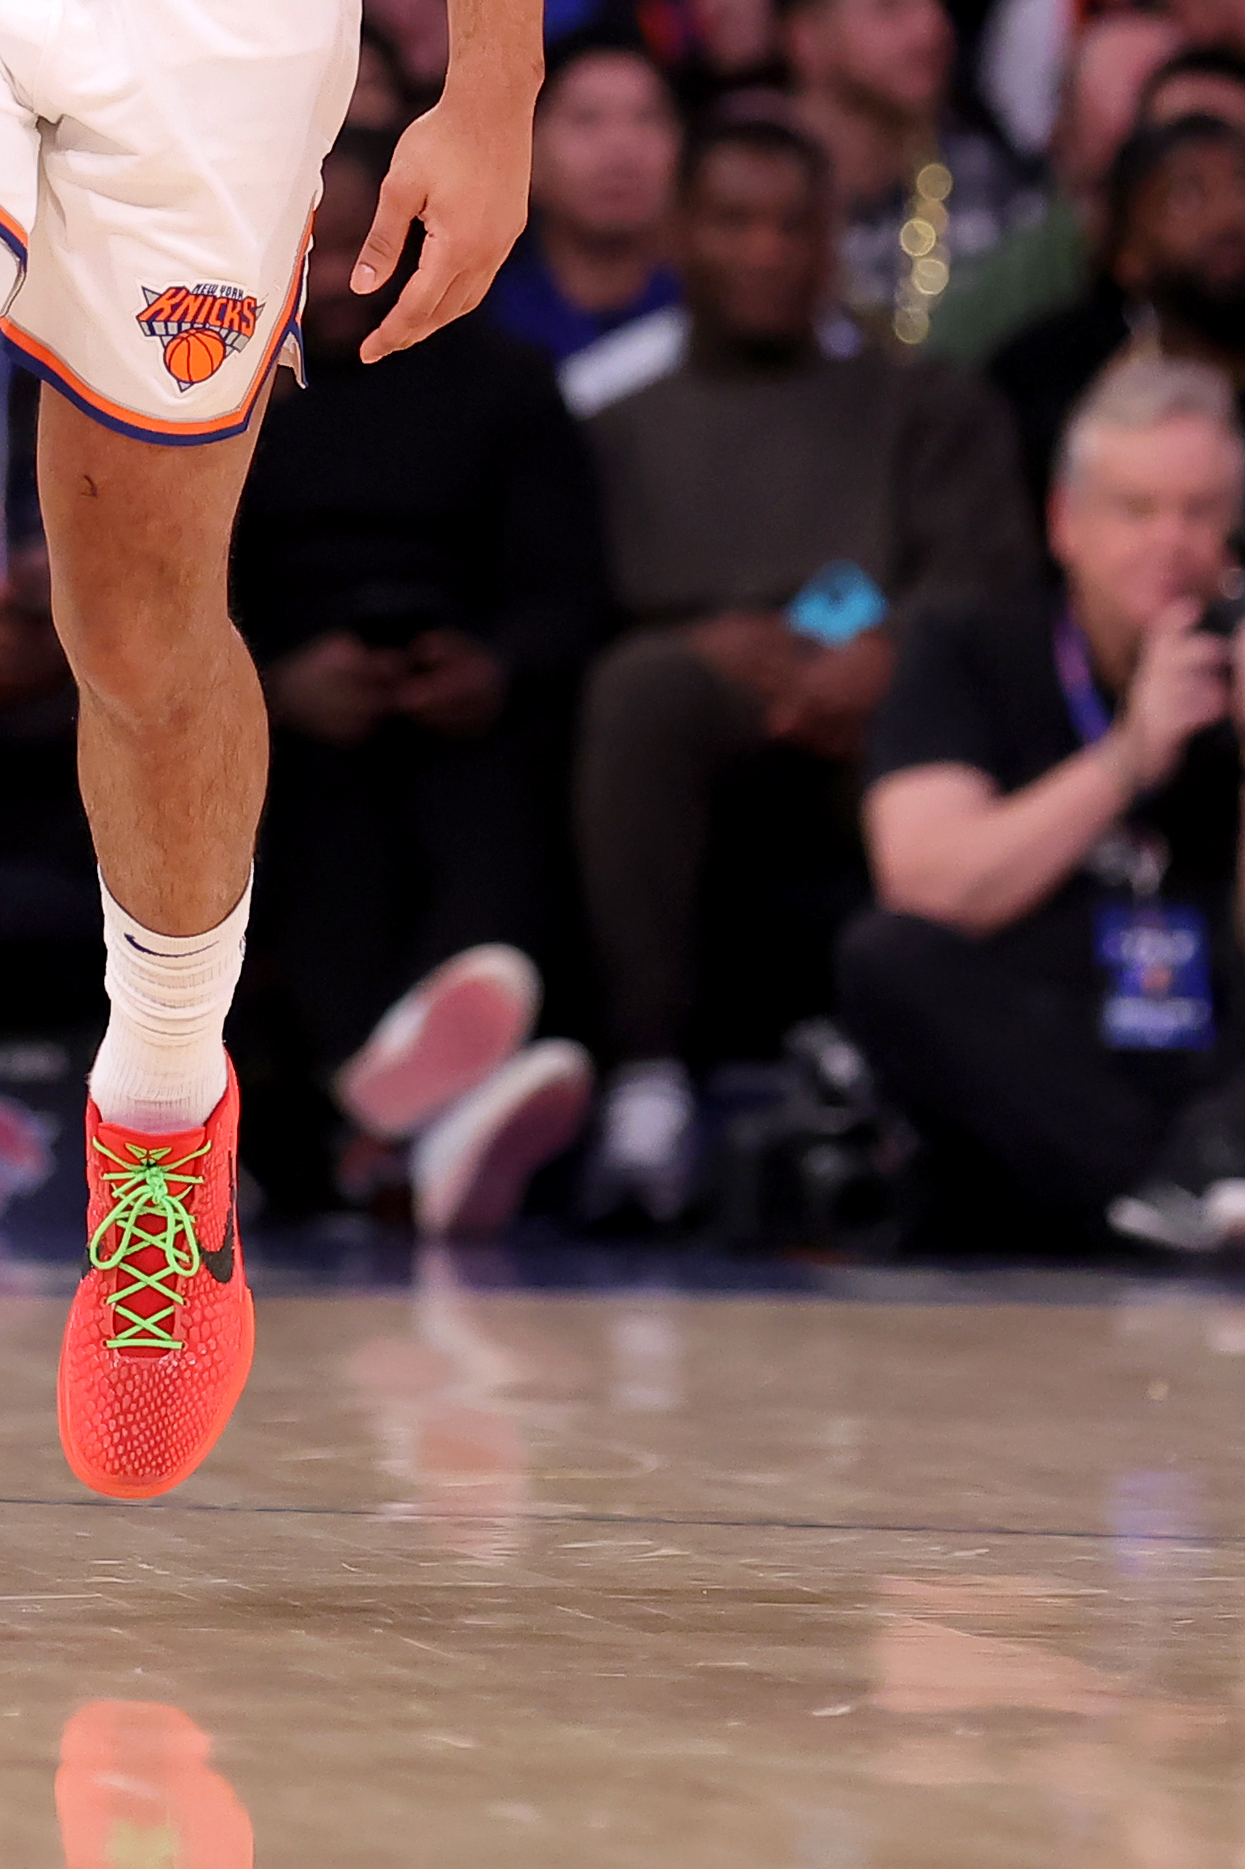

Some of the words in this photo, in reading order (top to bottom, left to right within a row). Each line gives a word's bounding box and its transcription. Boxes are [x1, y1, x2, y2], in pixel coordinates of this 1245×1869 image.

[192, 284, 218, 295] NEW
[220, 285, 244, 299] YORK
[137, 286, 257, 338] KNICKS
